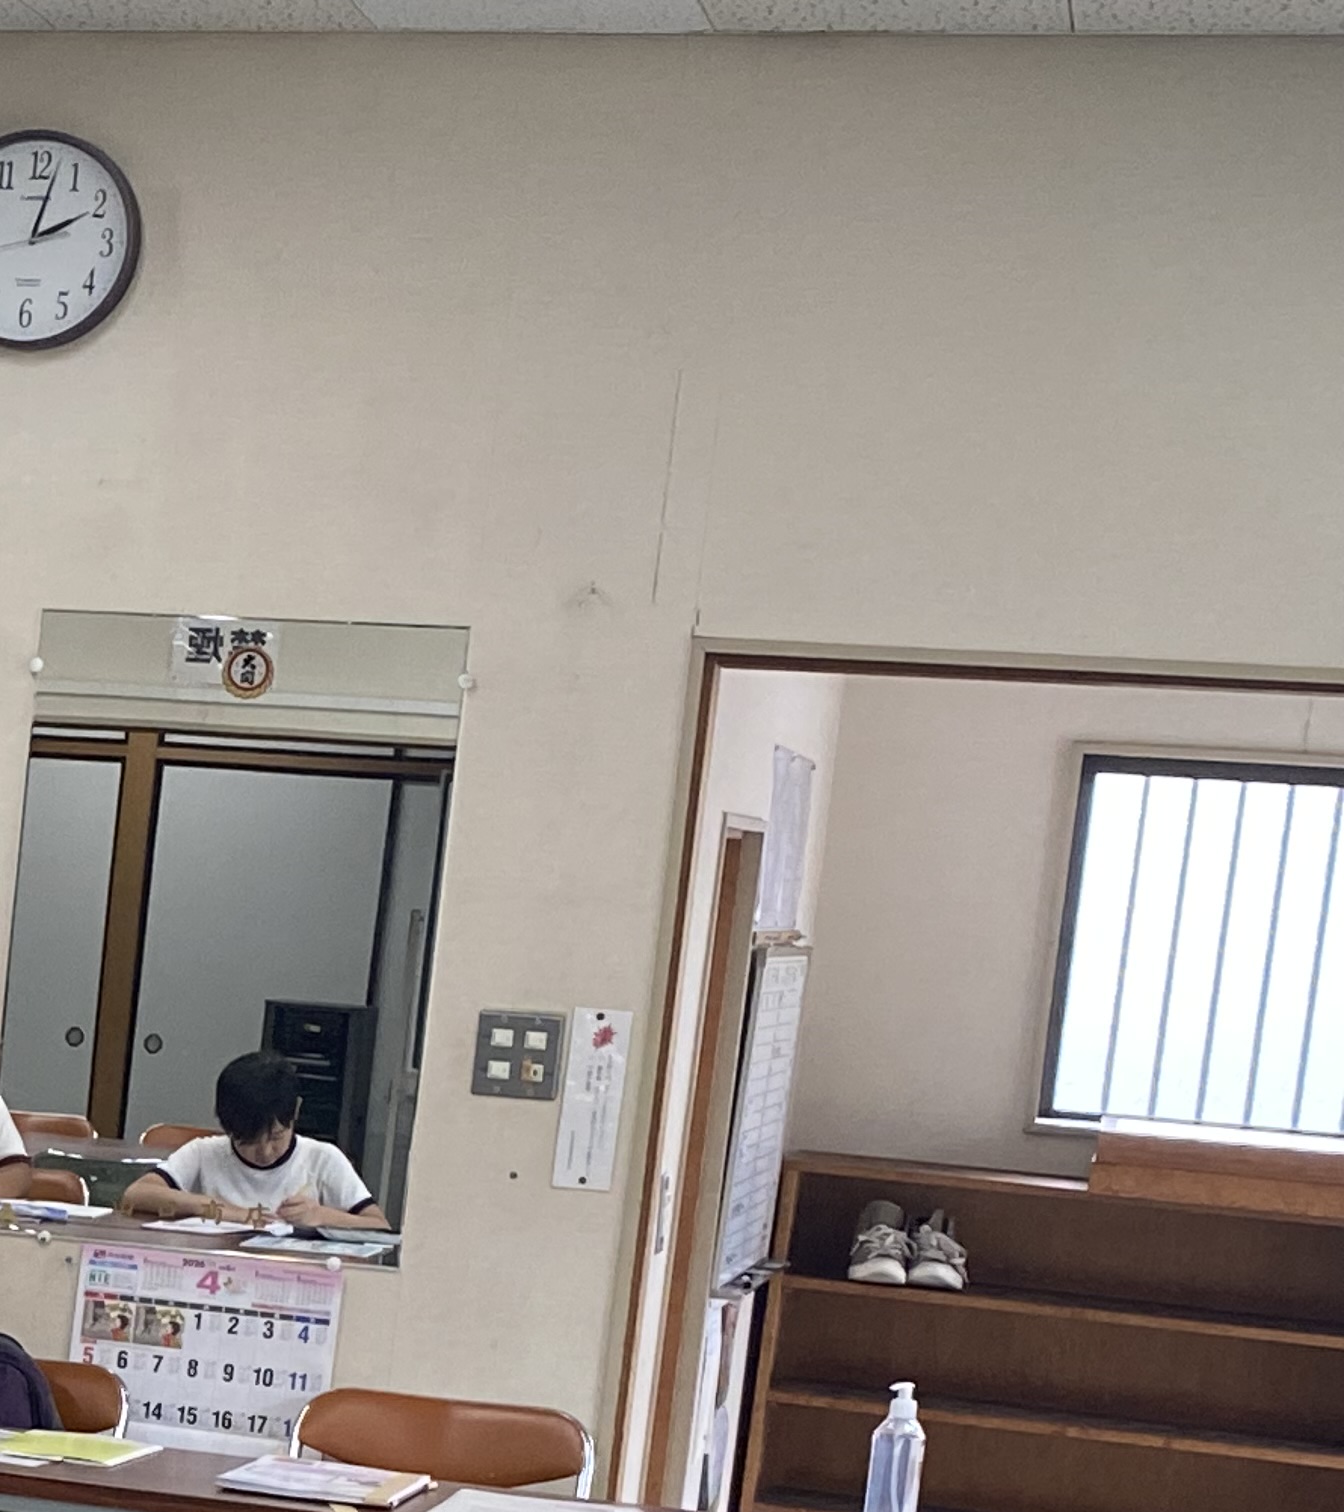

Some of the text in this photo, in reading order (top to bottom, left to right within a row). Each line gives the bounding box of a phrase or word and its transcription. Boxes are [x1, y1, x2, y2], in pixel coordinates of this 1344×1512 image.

[29, 150, 52, 180] 12
[69, 162, 79, 192] 1
[92, 189, 107, 218] 2
[99, 227, 115, 258] 3
[82, 267, 96, 296] 4
[19, 298, 32, 328] 6
[55, 290, 70, 320] 5
[182, 1258, 206, 1268] 2026
[196, 1271, 221, 1295] 4
[194, 1313, 203, 1330] 1
[228, 1317, 239, 1335] 2
[262, 1321, 274, 1339] 3
[298, 1326, 310, 1344] 4
[83, 1347, 308, 1392] 5 6 7 8 9 10 11
[143, 1402, 162, 1421] 14
[177, 1406, 198, 1425] 15
[212, 1410, 232, 1429] 16
[247, 1415, 267, 1434] 17
